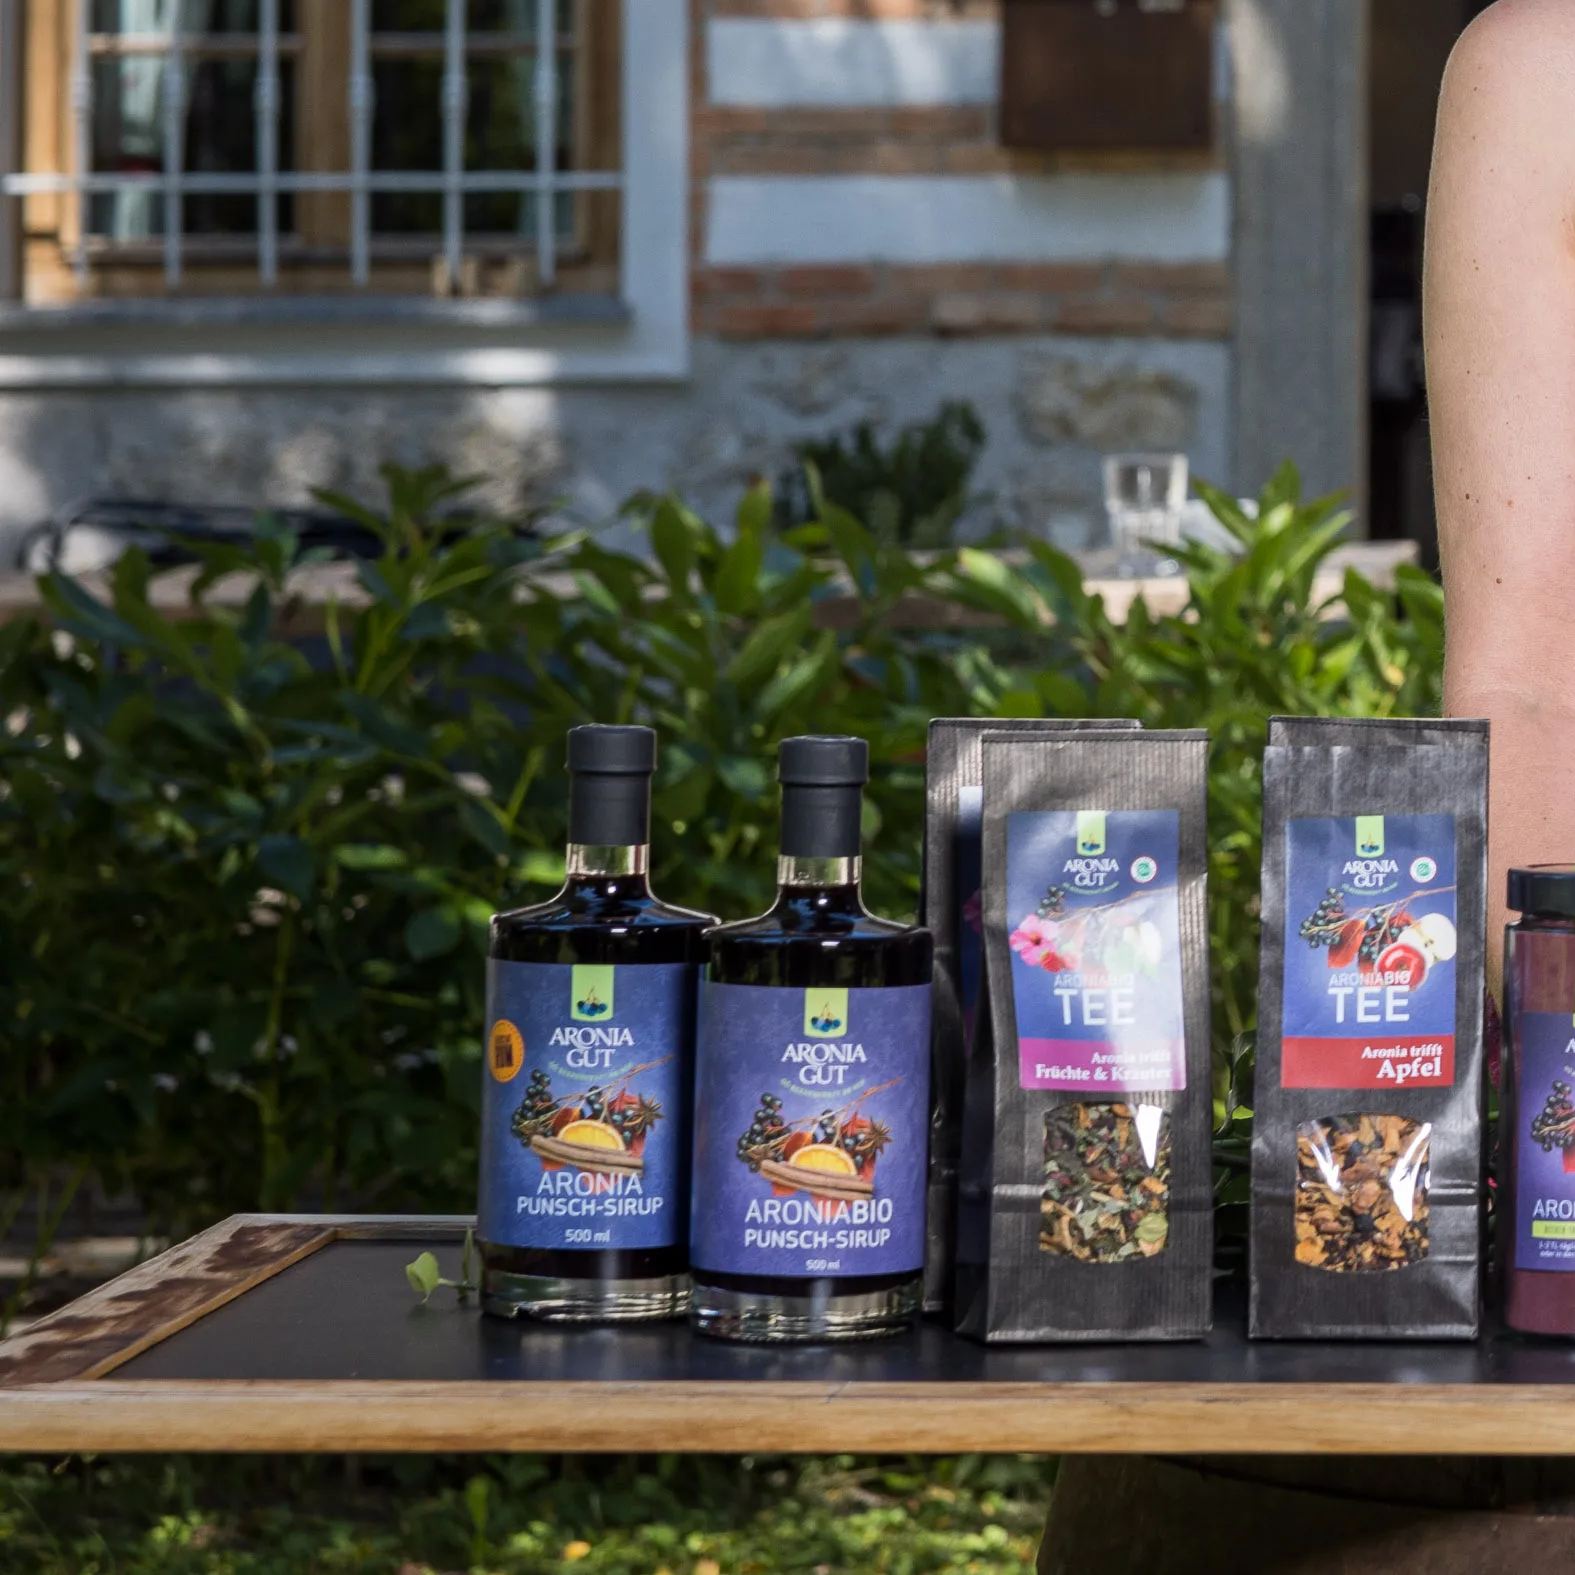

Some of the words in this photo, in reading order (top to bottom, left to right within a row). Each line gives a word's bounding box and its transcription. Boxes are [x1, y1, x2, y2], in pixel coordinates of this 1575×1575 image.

[1063, 858, 1120, 873] ARONIA
[1342, 859, 1399, 875] ARONIA
[1074, 872, 1107, 887] GUT
[1353, 873, 1387, 888] GUT
[1328, 970, 1411, 987] ARONIABIO
[1053, 988, 1136, 1026] TEE
[1327, 985, 1410, 1023] TEE
[549, 1027, 635, 1049] ARONIA
[566, 1048, 616, 1068] GUT
[781, 1043, 867, 1066] ARONIA
[1361, 1045, 1408, 1059] Aronia
[1410, 1043, 1443, 1058] trifft
[799, 1065, 849, 1085] GUT
[1035, 1063, 1090, 1081] Früchte
[1093, 1066, 1108, 1081] &
[1111, 1066, 1173, 1081] Kräuter
[1376, 1057, 1441, 1084] Apfel
[537, 1171, 644, 1197] ARONIA
[517, 1196, 664, 1216] PUNSCH-SIRUP
[745, 1198, 893, 1225] ARONIABIO
[565, 1229, 592, 1243] 500
[593, 1229, 611, 1243] ml
[745, 1228, 891, 1249] PUNSCH-SIRUP
[805, 1259, 827, 1271] 500
